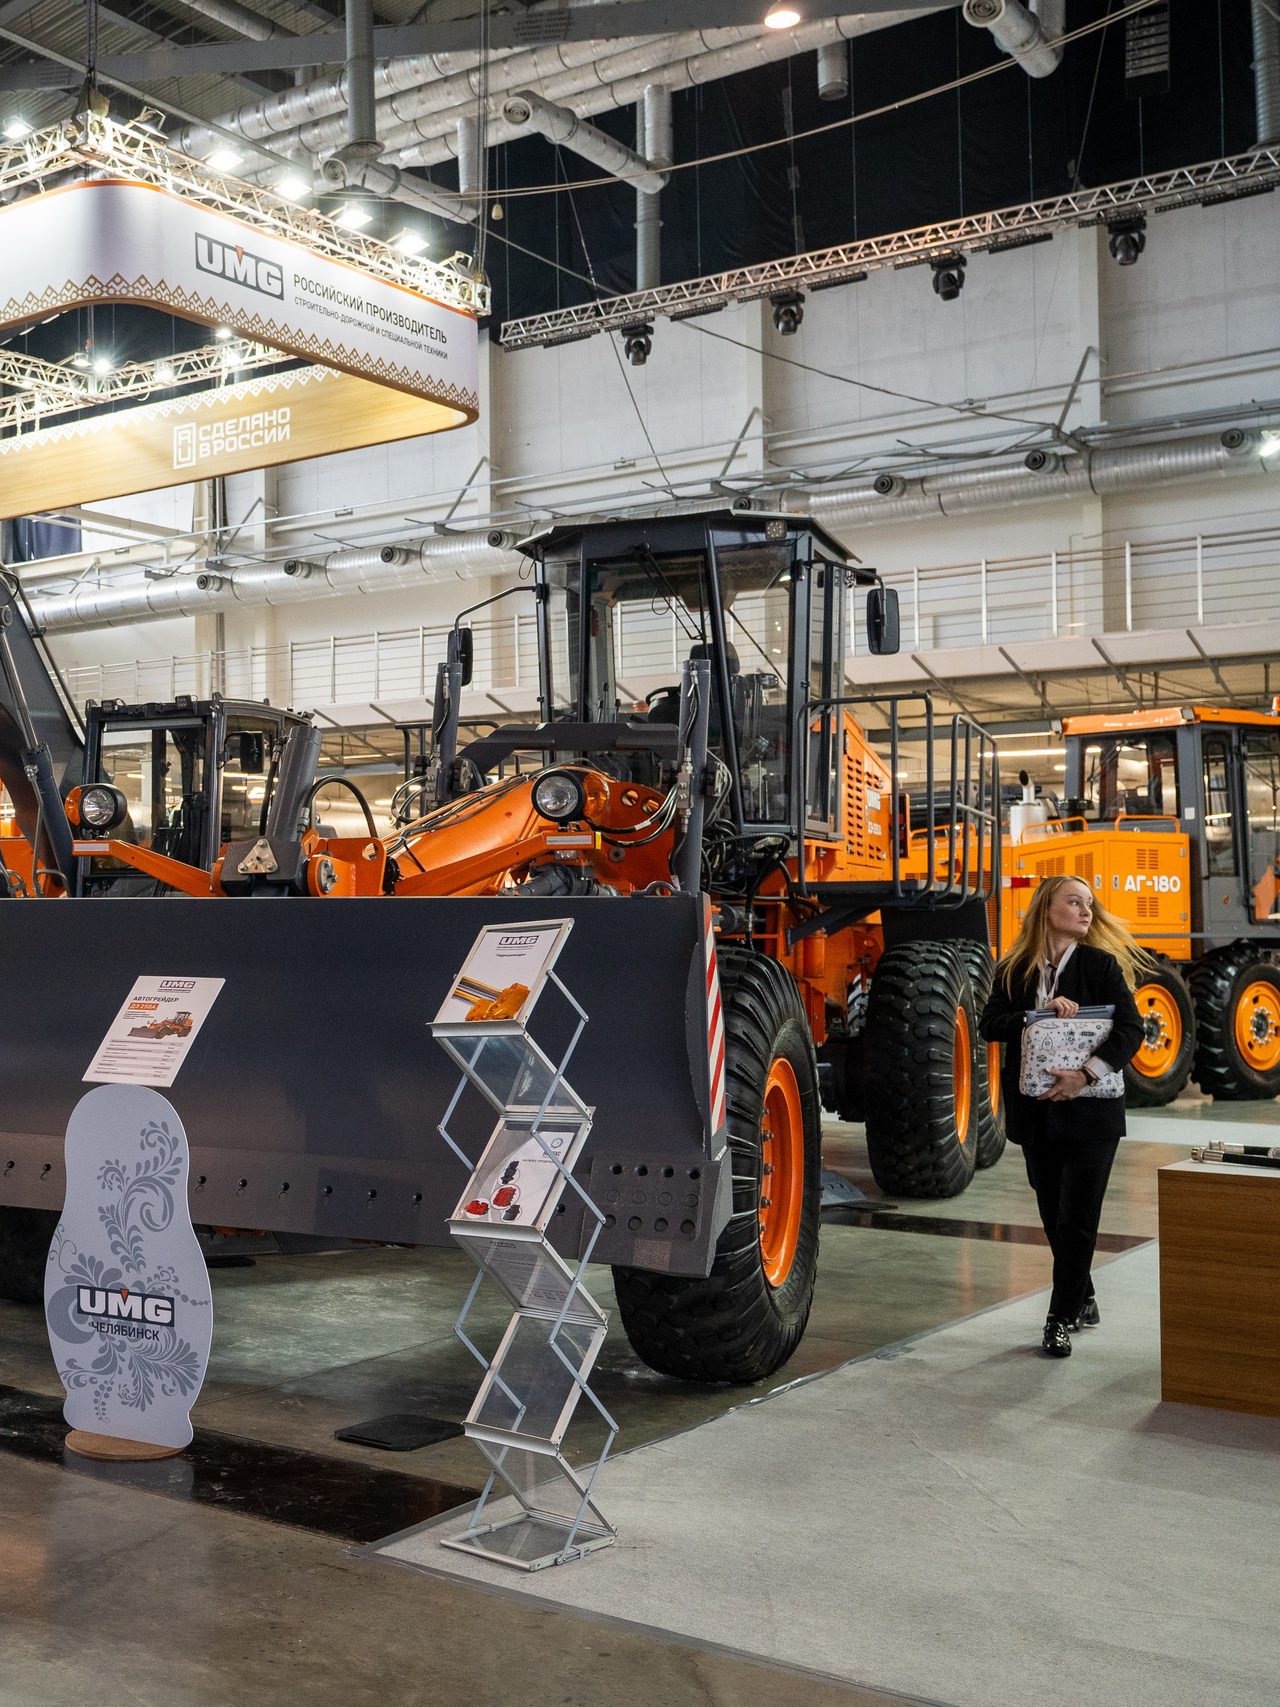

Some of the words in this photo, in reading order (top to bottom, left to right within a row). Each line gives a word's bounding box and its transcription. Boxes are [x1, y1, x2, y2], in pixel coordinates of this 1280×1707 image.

[197, 236, 284, 297] UMG
[293, 274, 364, 313] РОССИЙСКИЙ
[366, 302, 448, 345] ПРОИЗВОДИТЕЛЬ
[294, 296, 375, 333] СТРОИТЕЛЬНО-ДОРОЖНОЙ
[381, 329, 423, 350] СПЕЦИАЛЬНОЙ
[423, 342, 448, 360] ТЕХНИКИ
[198, 407, 291, 441] СДЕЛАНО
[213, 424, 291, 456] РОССИИ
[1123, 874, 1181, 893] АГ-180
[500, 935, 539, 946] UMG
[133, 995, 180, 1003] АВТОГРЕЙДЕР
[160, 980, 196, 989] UMG
[79, 1287, 173, 1325] UMG
[91, 1321, 160, 1341] ЧЕЛЯБИНСК
